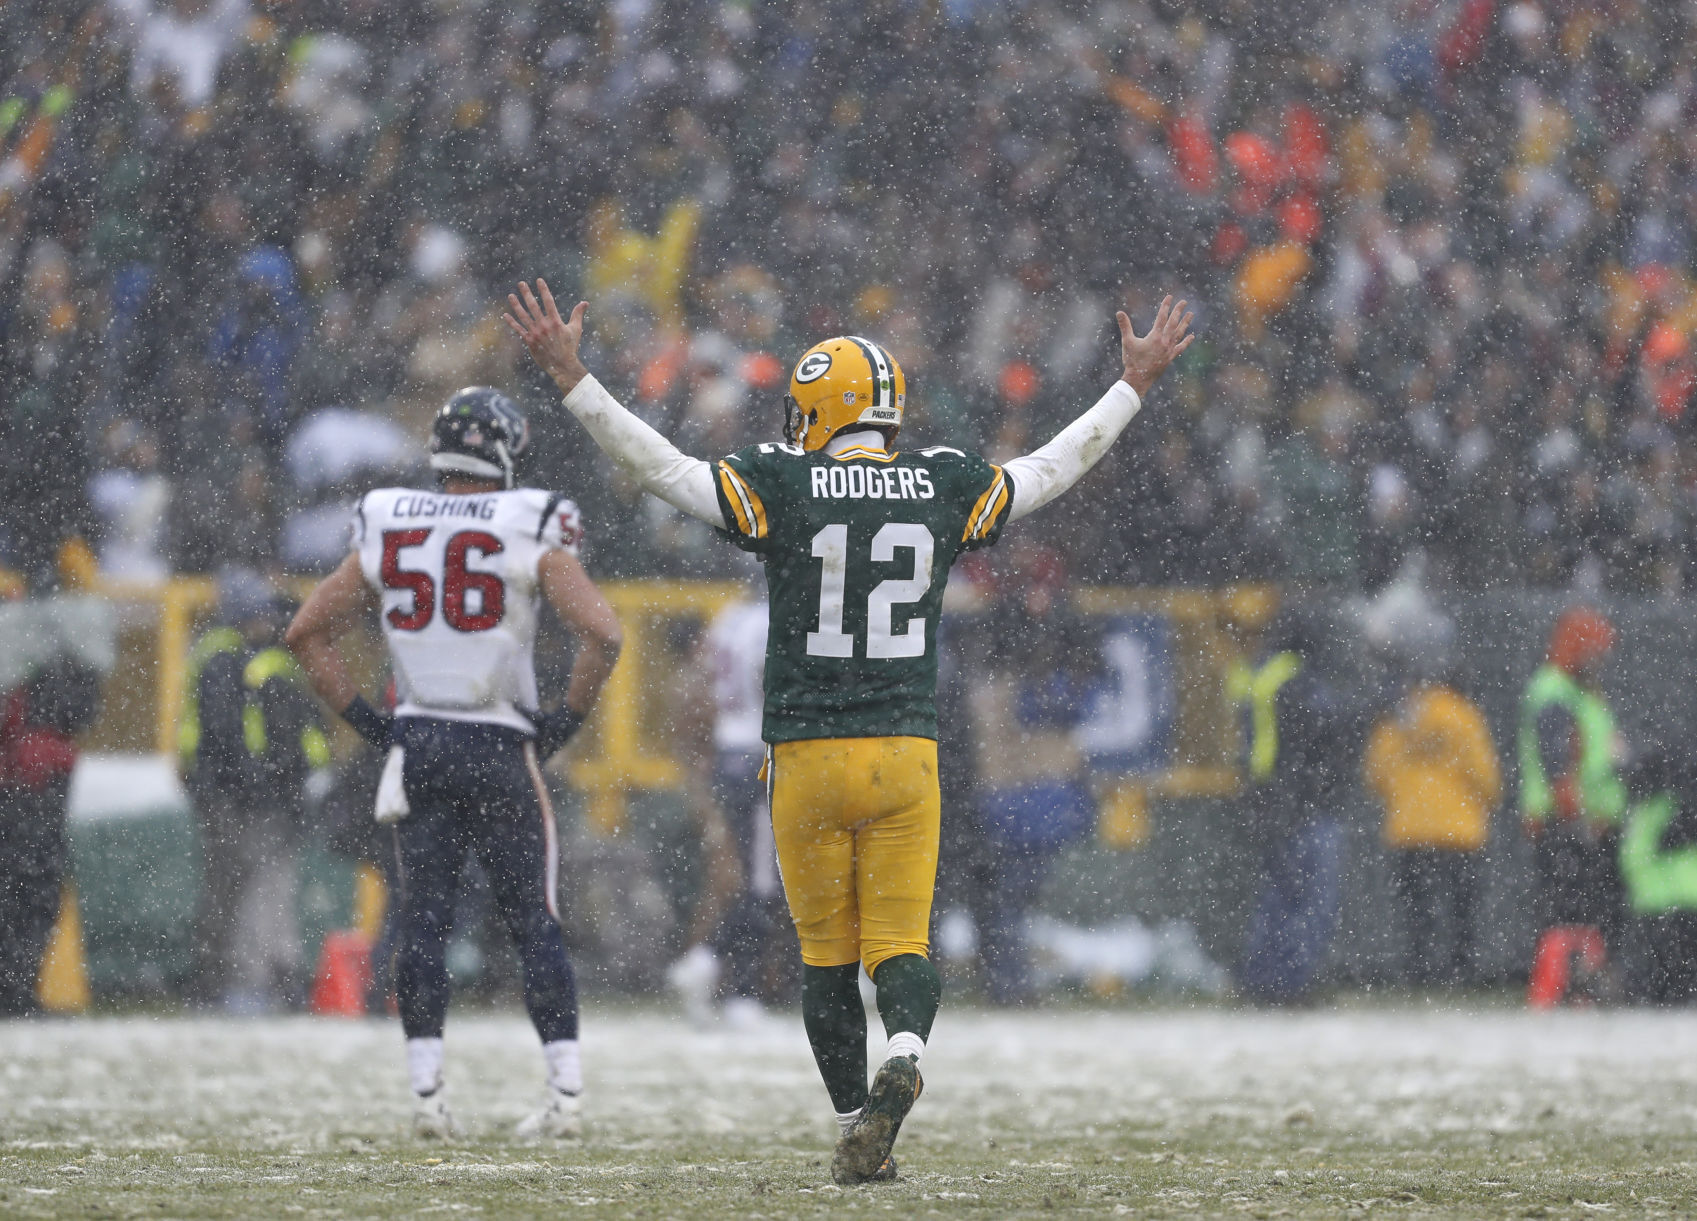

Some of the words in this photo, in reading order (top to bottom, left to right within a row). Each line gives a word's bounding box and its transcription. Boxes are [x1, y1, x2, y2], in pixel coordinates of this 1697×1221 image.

[796, 352, 832, 384] G
[872, 410, 896, 419] PACKERS
[811, 465, 935, 499] RODGERS
[393, 496, 498, 520] CUSHING
[381, 528, 505, 632] 56
[806, 523, 935, 659] 12
